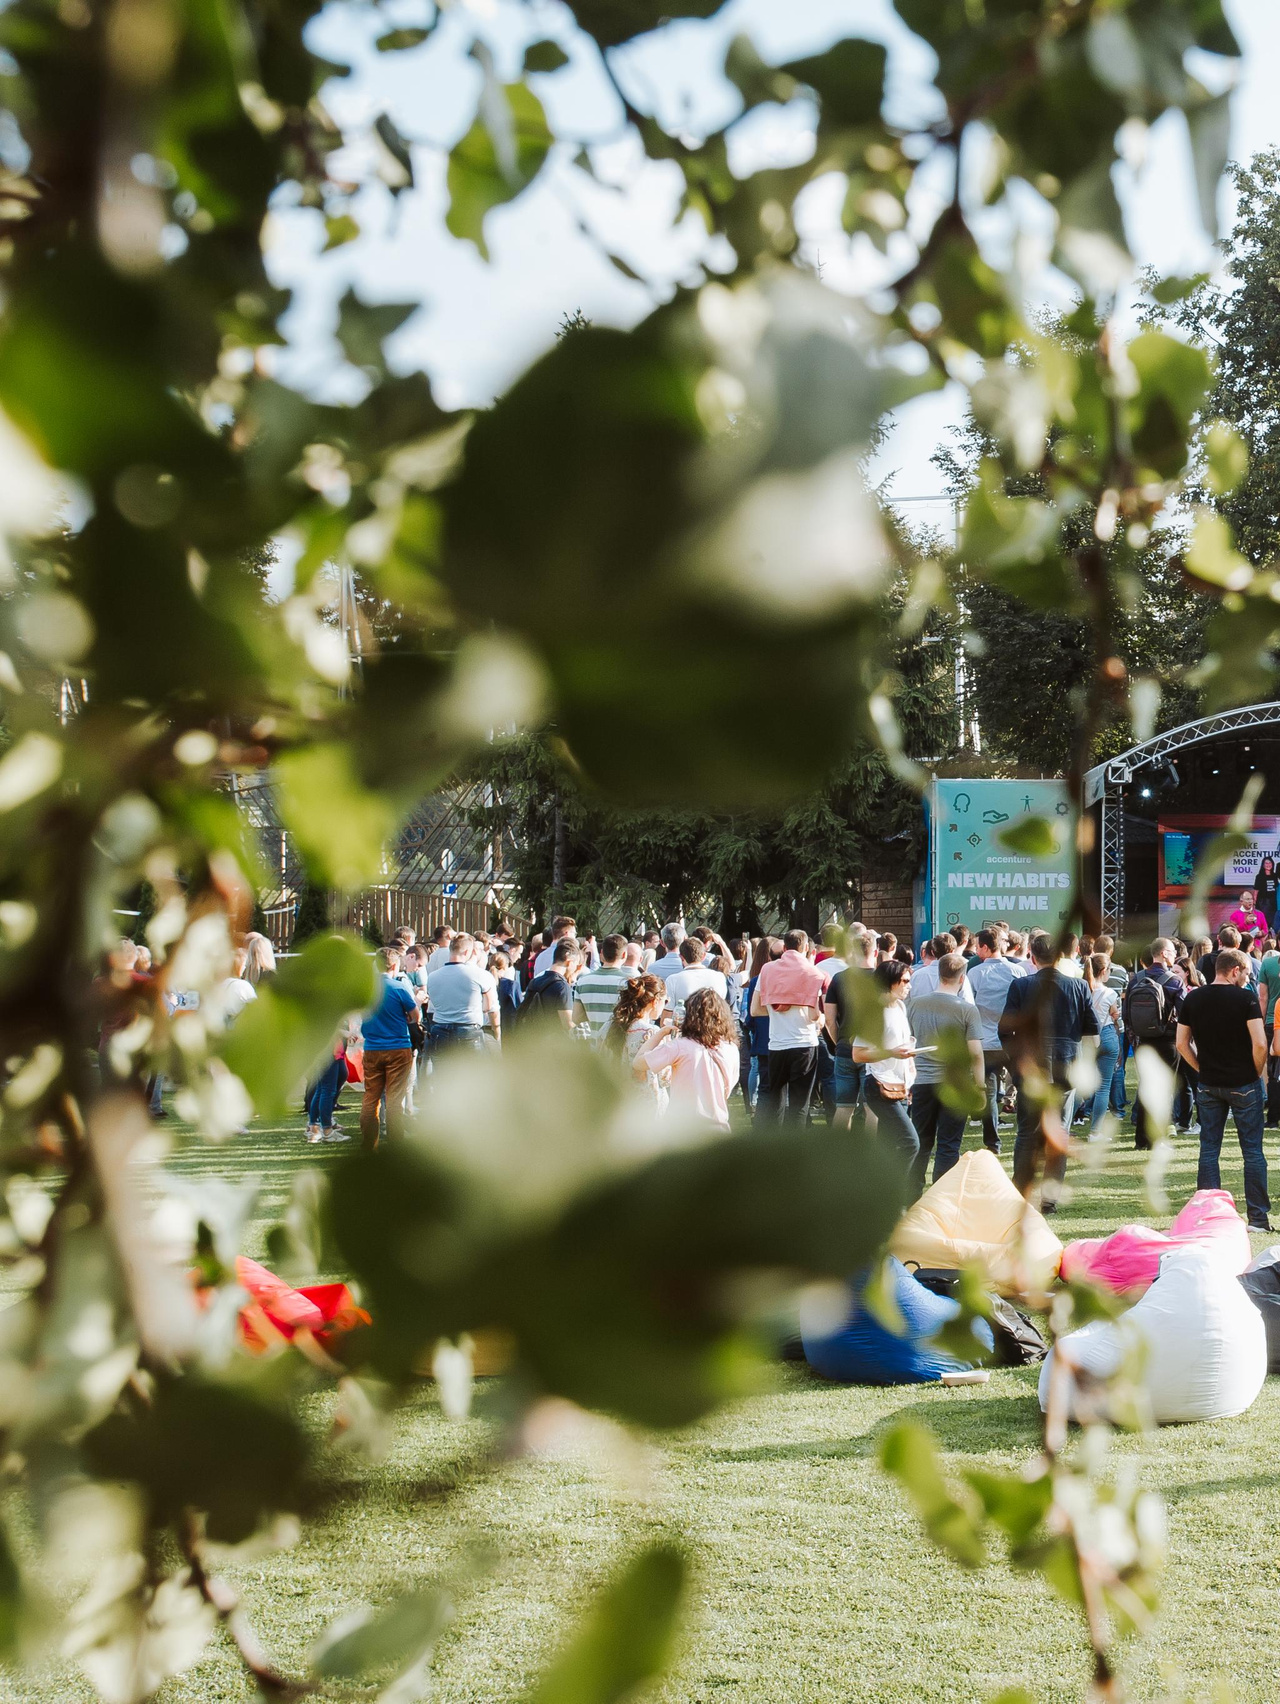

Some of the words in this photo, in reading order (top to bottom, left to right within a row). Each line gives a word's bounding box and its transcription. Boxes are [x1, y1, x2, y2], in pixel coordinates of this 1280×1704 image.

[986, 855, 1032, 864] accenture
[1233, 866, 1253, 874] YOU.
[947, 872, 994, 888] NEW
[996, 872, 1071, 888] HABITS
[969, 895, 1017, 911] NEW
[1018, 895, 1049, 911] ME
